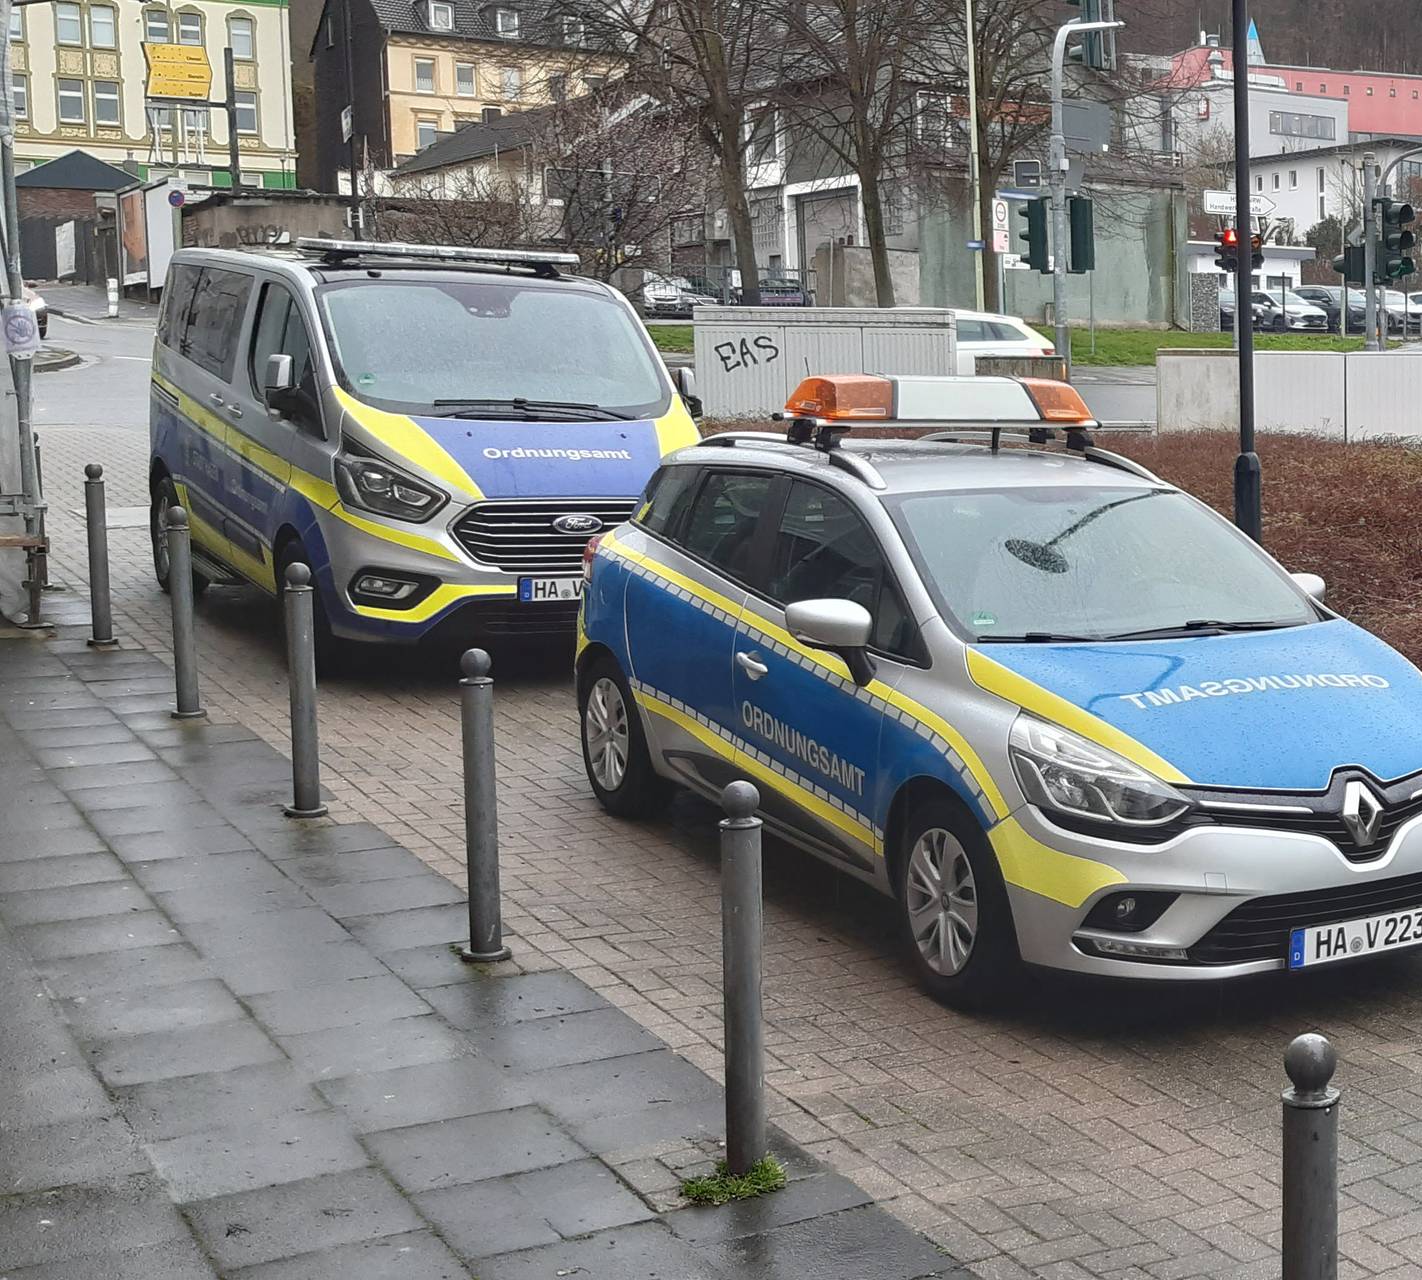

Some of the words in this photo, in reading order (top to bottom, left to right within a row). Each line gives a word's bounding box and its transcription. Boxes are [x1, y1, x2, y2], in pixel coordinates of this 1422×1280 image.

[714, 336, 779, 372] EAS
[483, 447, 632, 461] Ordnungsamt
[565, 518, 593, 529] Ford
[534, 580, 559, 599] HA
[742, 700, 866, 797] ORDNUNGSAMT
[1315, 924, 1347, 959] HA
